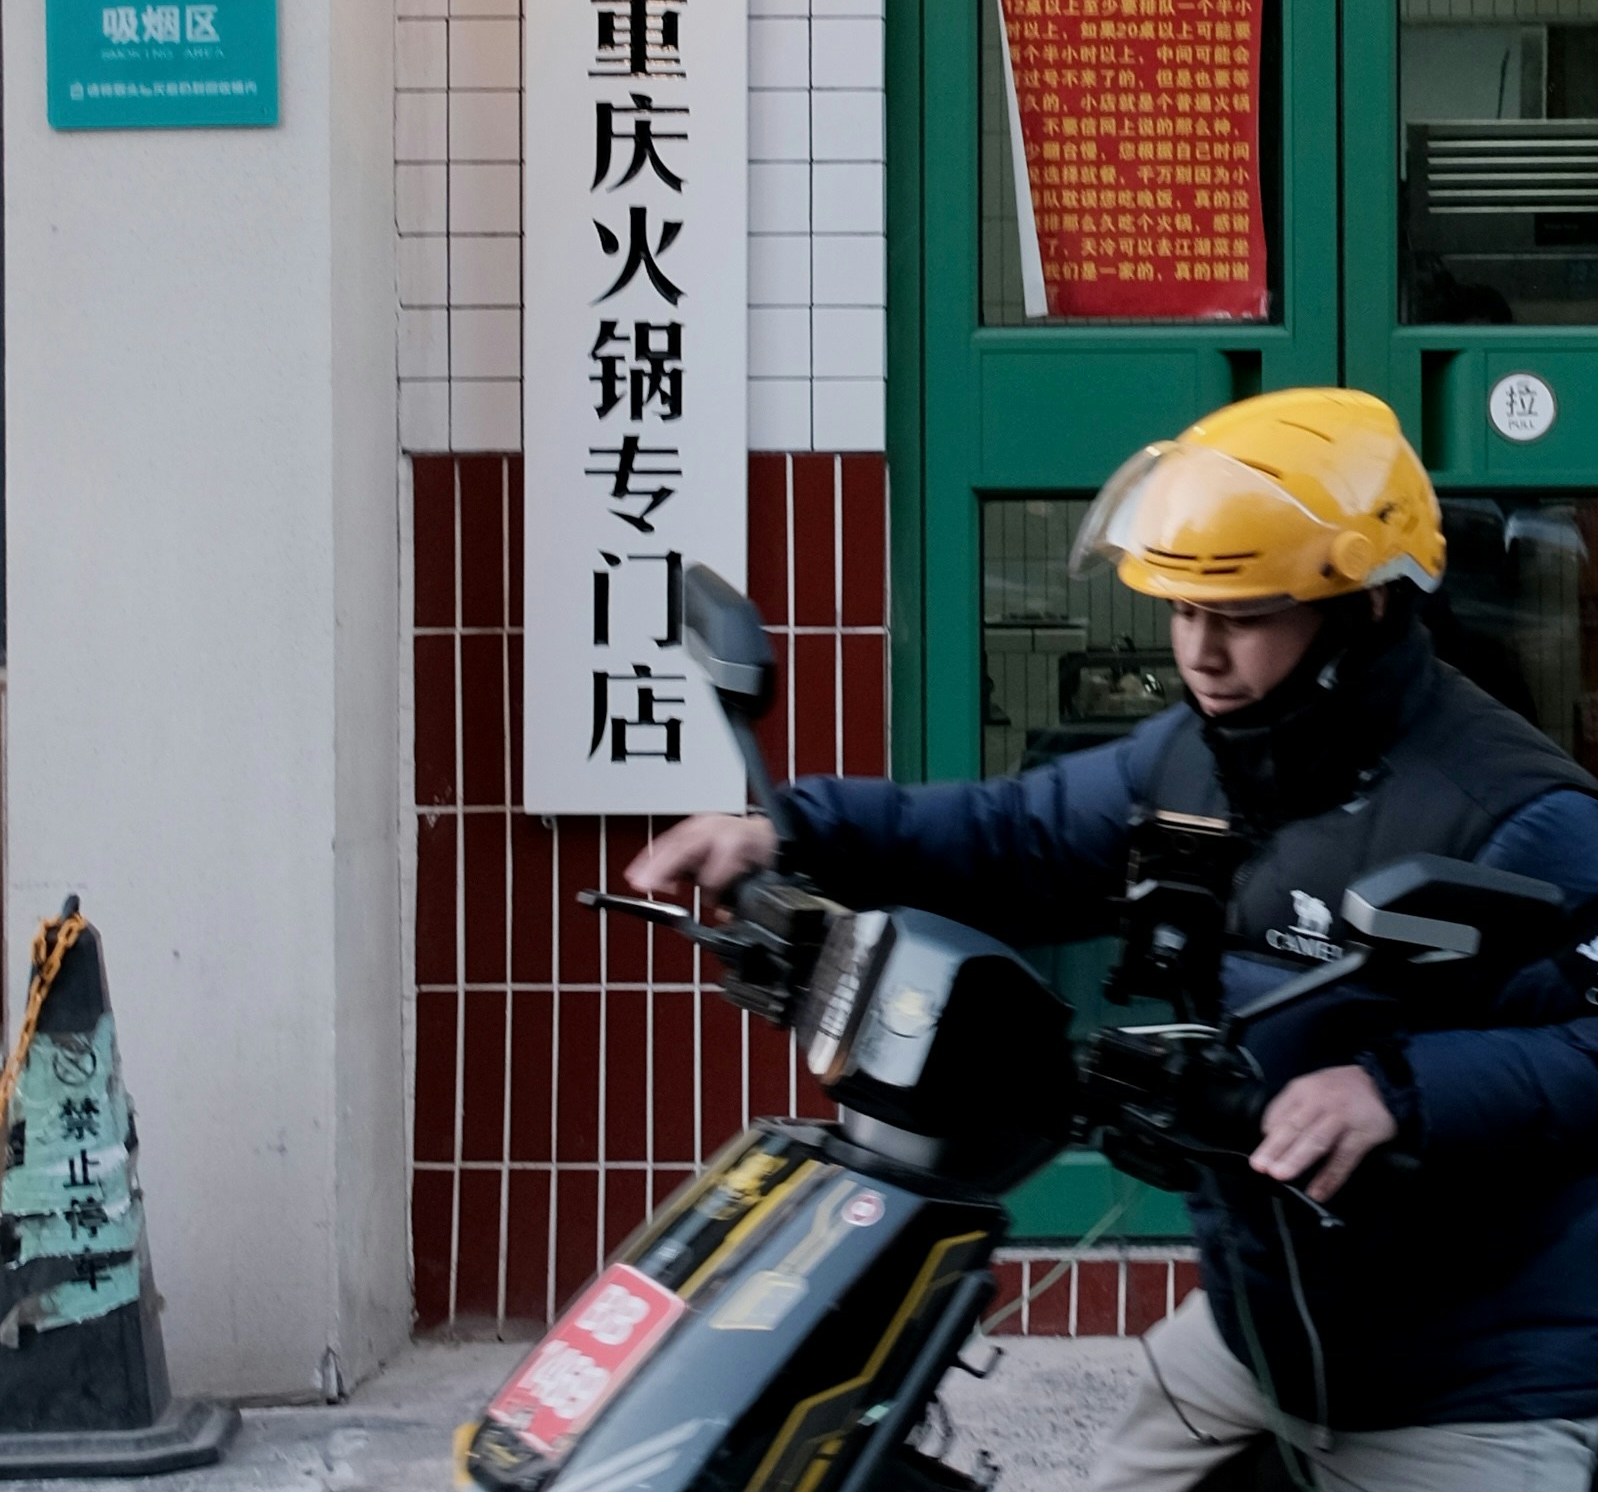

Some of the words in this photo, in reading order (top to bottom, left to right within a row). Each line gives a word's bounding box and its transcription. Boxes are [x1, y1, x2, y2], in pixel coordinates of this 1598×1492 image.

[102, 4, 220, 45] 吸烟区
[1504, 384, 1539, 417] 拉
